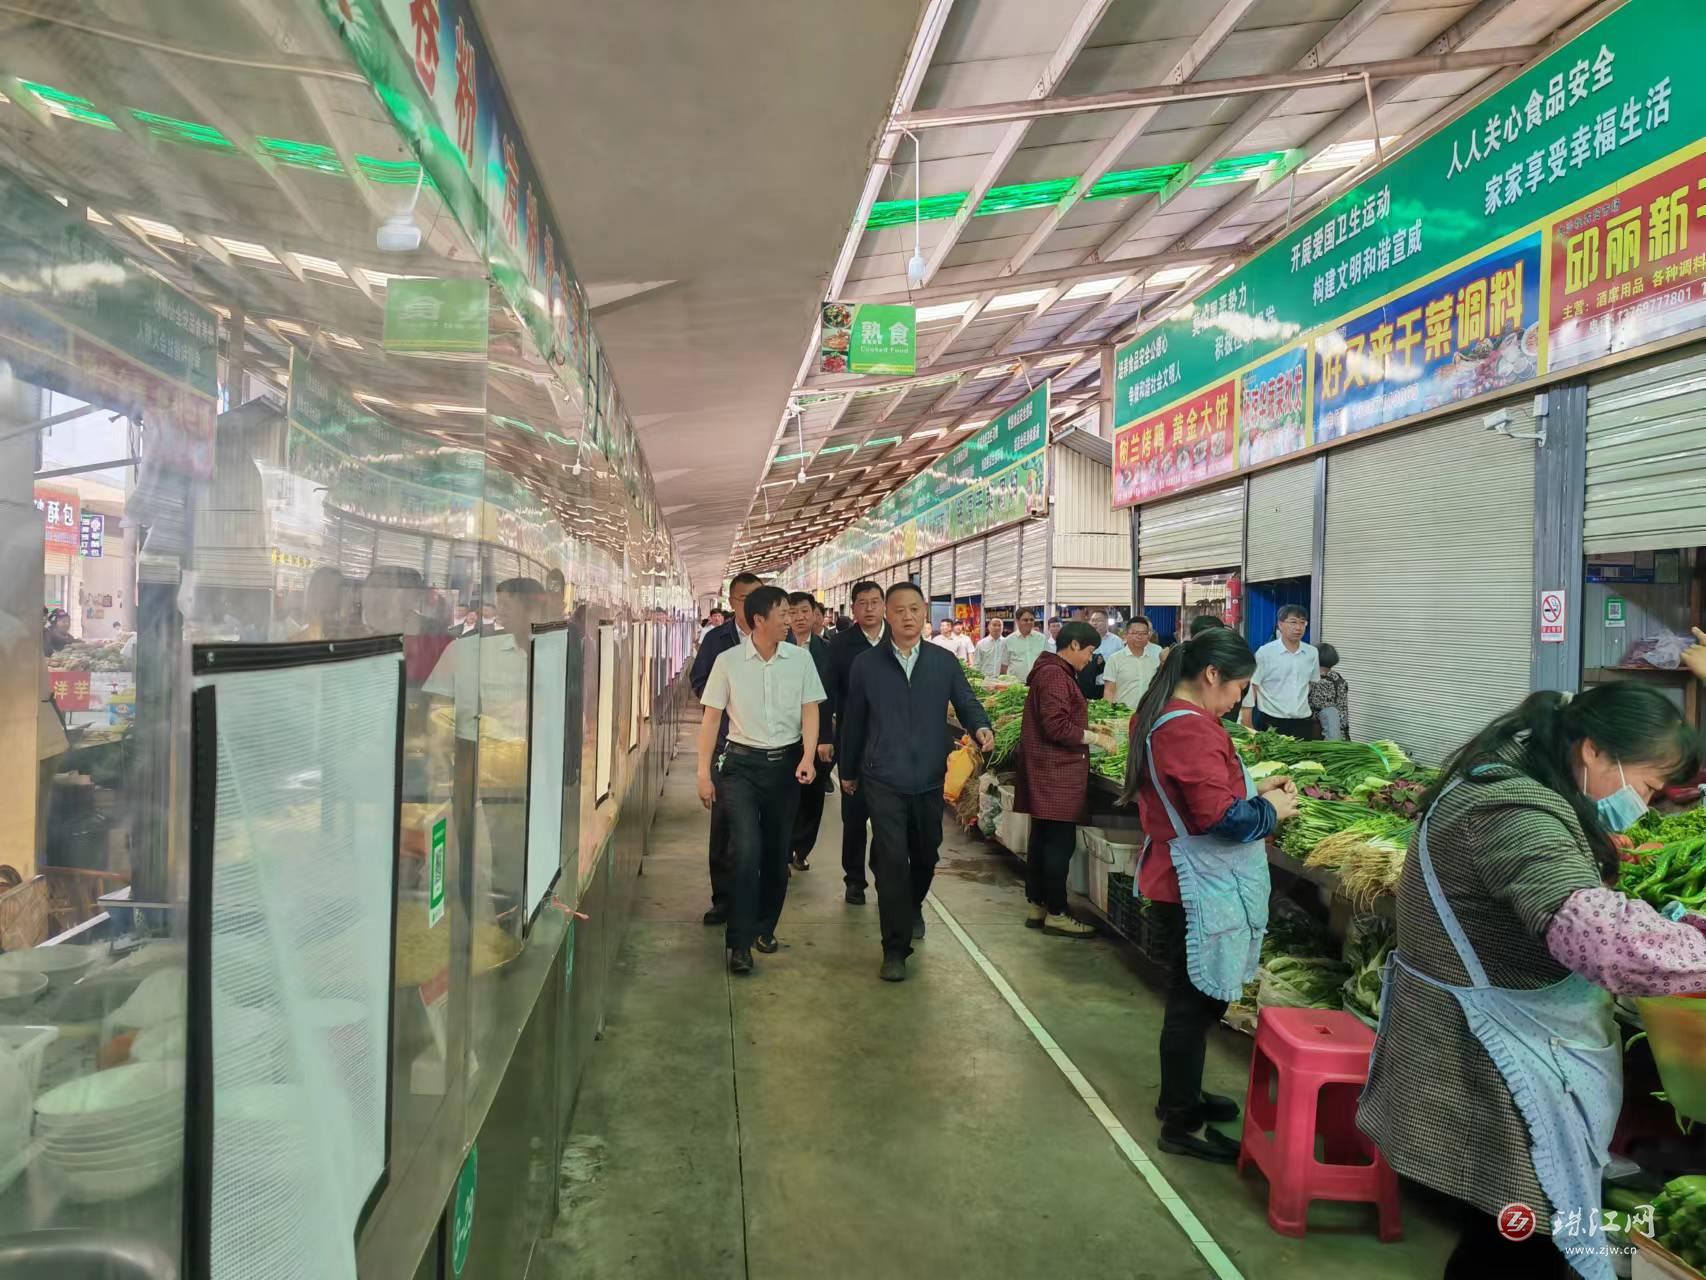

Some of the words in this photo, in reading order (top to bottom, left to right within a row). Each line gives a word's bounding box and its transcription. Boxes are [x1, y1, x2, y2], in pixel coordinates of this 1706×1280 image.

[1446, 43, 1616, 180] 人人关心食品安全
[1483, 75, 1672, 217] 家家享受幸福生活
[1291, 184, 1391, 273] 开展爱国卫生运动
[1312, 218, 1422, 306] 构建文明和谐宣威
[1564, 177, 1706, 297] 邱丽新
[861, 320, 910, 347] 熟食
[1321, 259, 1524, 401] 好又来干菜调料
[1596, 277, 1644, 309] 酒席用品
[1171, 391, 1230, 448] 黄金大饼
[54, 679, 89, 700] 洋芋
